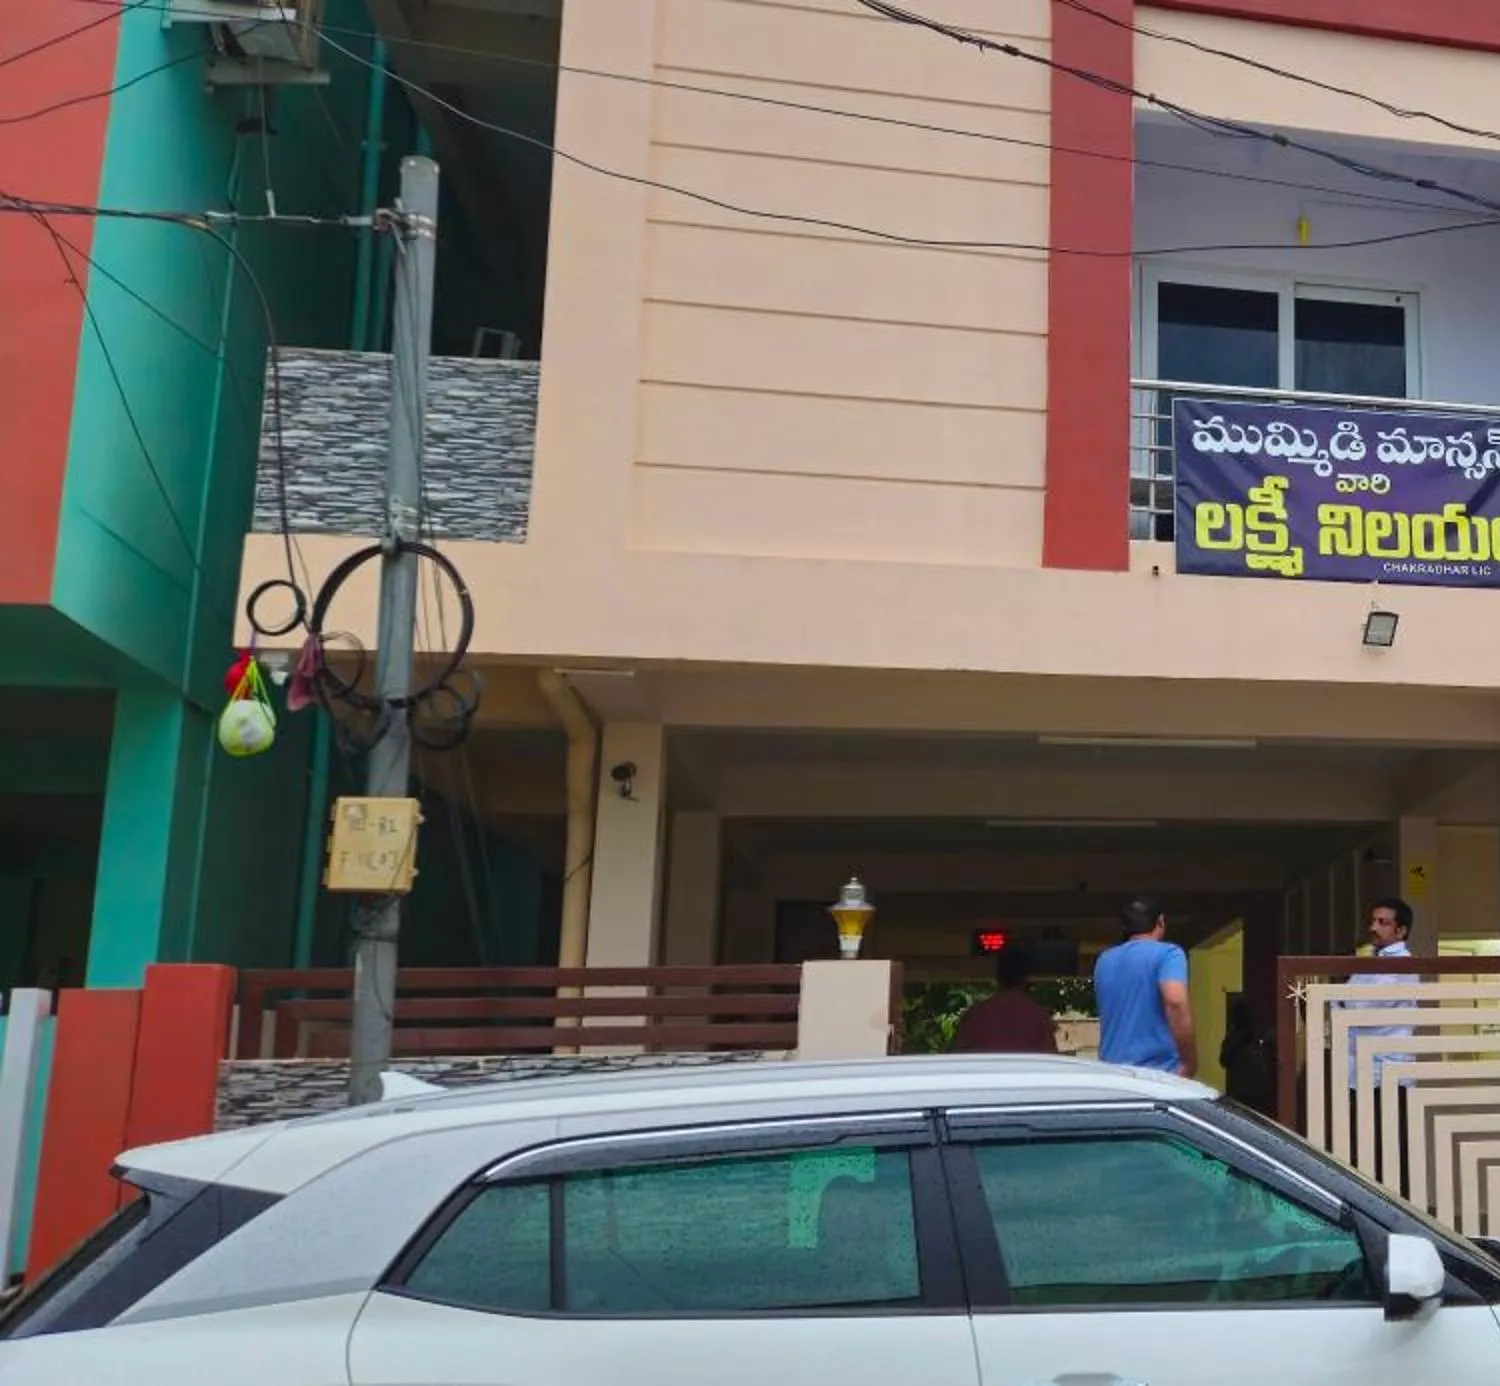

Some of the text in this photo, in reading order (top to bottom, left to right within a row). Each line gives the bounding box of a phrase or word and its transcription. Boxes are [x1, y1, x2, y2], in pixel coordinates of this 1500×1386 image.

[1192, 415, 1367, 478] ముమ్మిడి
[1335, 472, 1392, 495] వారి
[1195, 474, 1305, 577] లక్ష్మీ
[1383, 562, 1493, 577] CHAKRADHAR LIC
